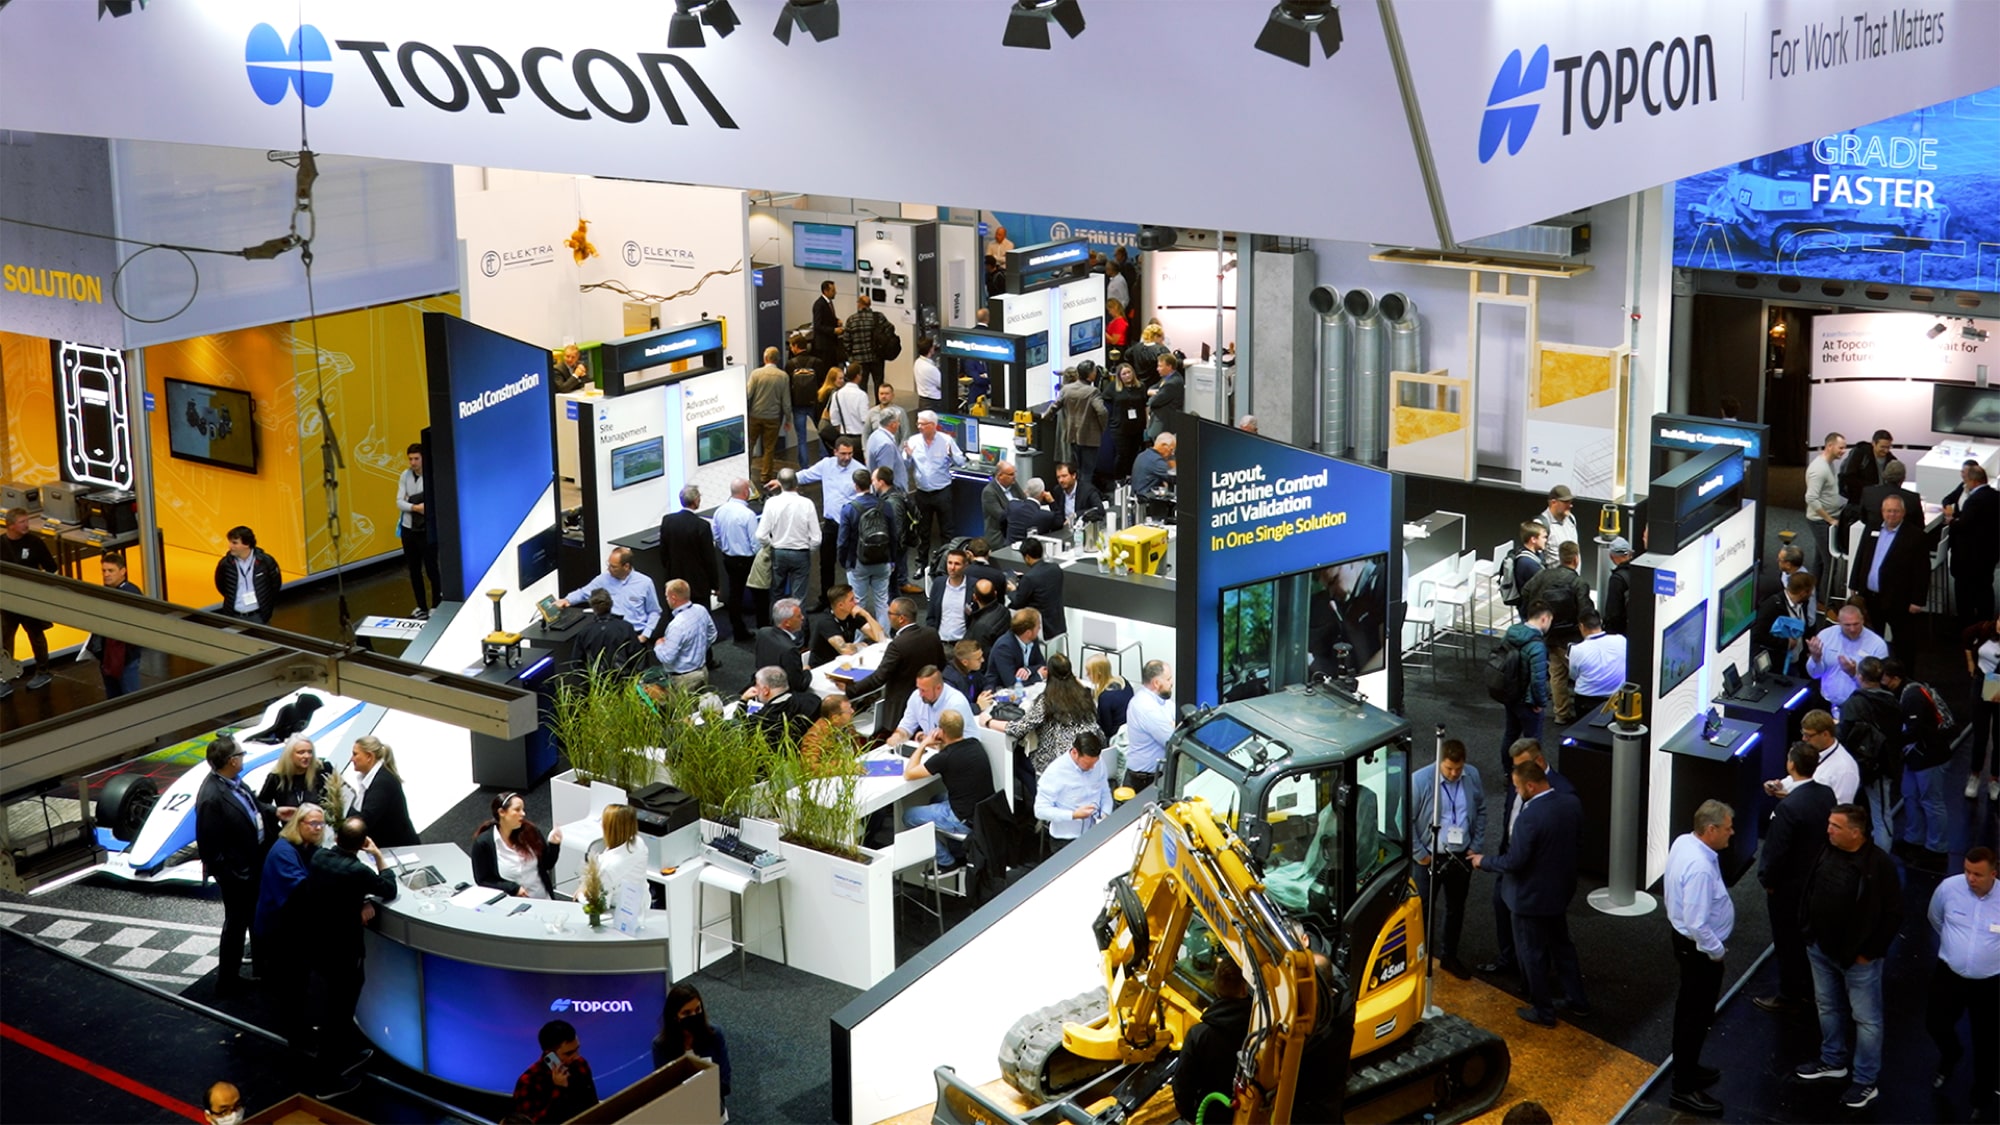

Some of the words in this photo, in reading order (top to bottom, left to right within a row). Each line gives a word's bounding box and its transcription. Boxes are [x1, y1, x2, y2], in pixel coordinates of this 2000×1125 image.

[1769, 29, 1800, 80] For
[1805, 16, 1849, 72] Work
[1854, 12, 1887, 61] That
[1891, 8, 1944, 53] Matters
[334, 40, 740, 130] TOPCON
[1553, 33, 1718, 136] TOPCON
[1812, 134, 1938, 170] GRADE
[1812, 174, 1935, 209] FASTER
[1110, 231, 1138, 247] LUT
[503, 244, 553, 261] ELEKTRA
[643, 246, 695, 259] ELEKTRA
[3, 264, 103, 304] SOLUTION
[1822, 340, 1834, 350] At
[1961, 342, 1978, 353] for
[1822, 352, 1839, 363] the
[458, 390, 484, 420] Road
[484, 372, 540, 407] Construction
[686, 395, 719, 411] Advanced
[686, 404, 726, 422] Compaction
[599, 422, 614, 434] Site
[600, 425, 648, 445] Management
[1211, 464, 1266, 489] Layout,
[1211, 483, 1273, 509] Machine
[1275, 469, 1328, 496] Control
[1211, 508, 1238, 528] and
[1239, 494, 1312, 523] Validation
[1211, 535, 1224, 551] In
[1226, 530, 1254, 549] One
[1255, 519, 1294, 542] Single
[1295, 510, 1346, 534] Solution
[162, 793, 191, 812] 12
[571, 1000, 633, 1013] TOPCON
